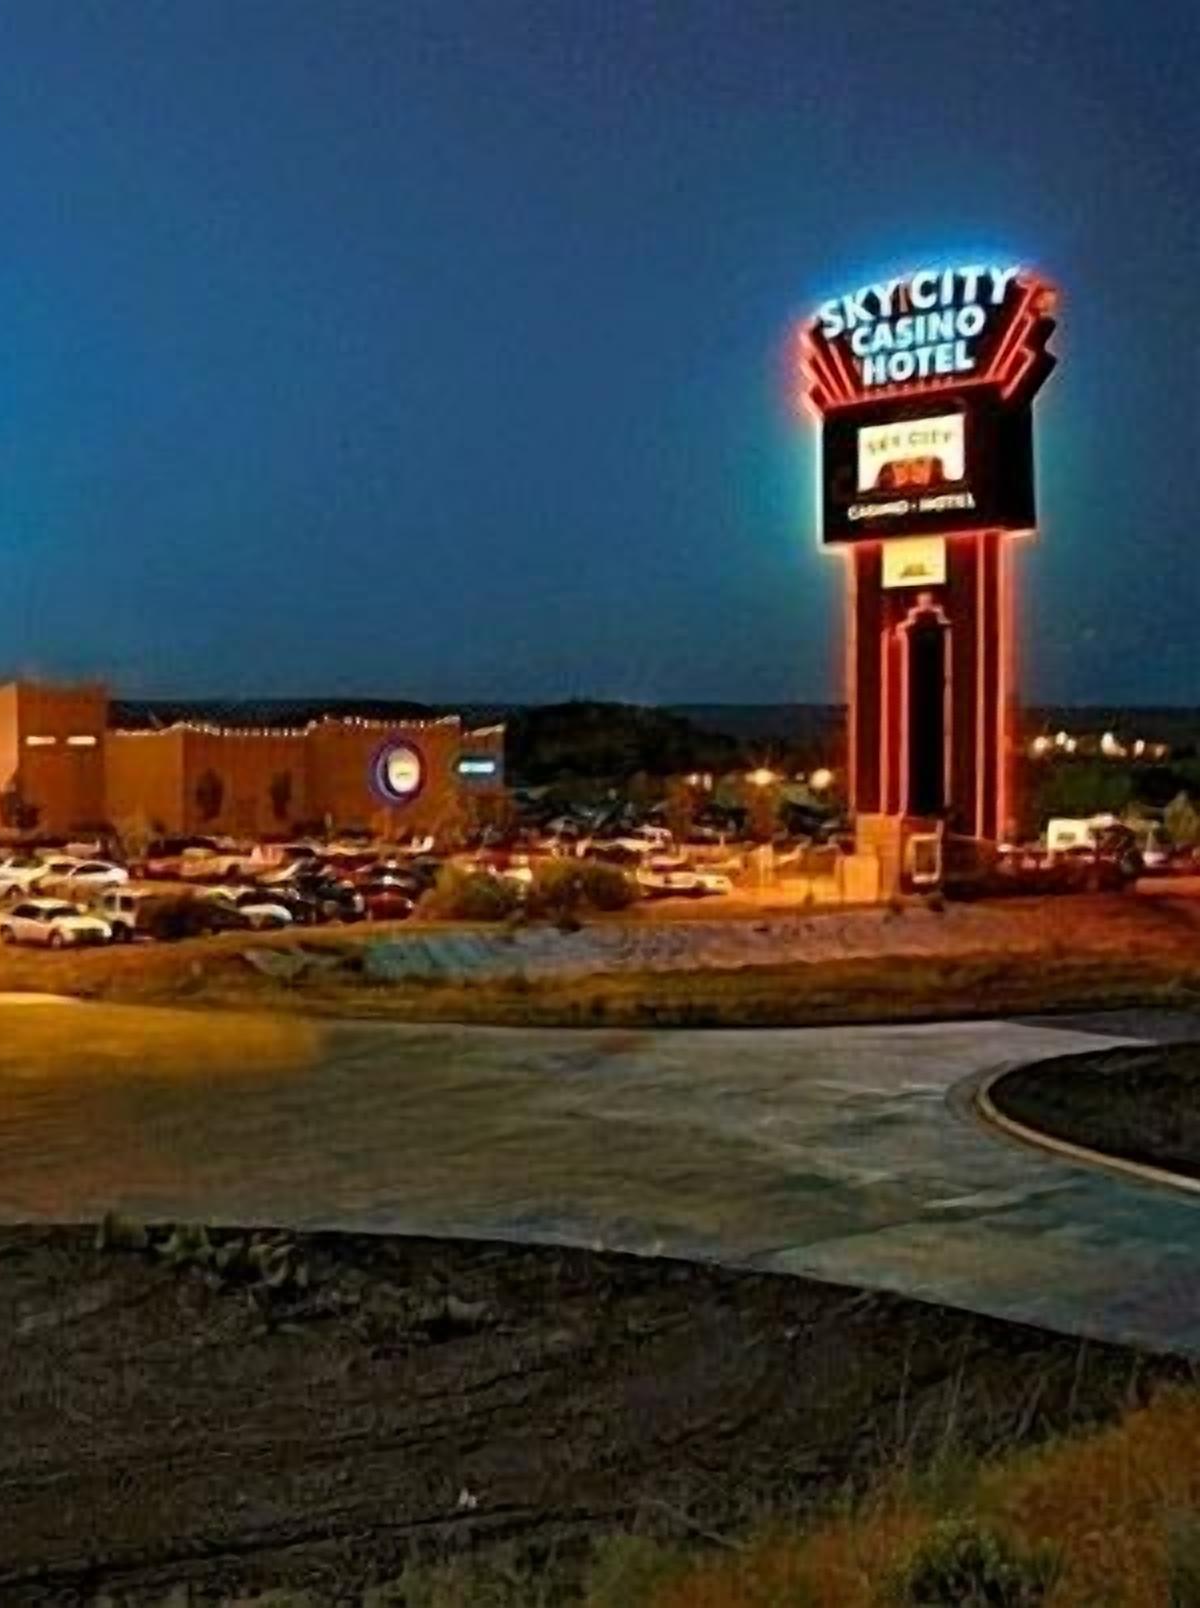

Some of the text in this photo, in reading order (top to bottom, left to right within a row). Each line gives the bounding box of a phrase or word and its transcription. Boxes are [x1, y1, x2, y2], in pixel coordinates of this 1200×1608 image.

[819, 266, 1019, 338] SKY CITY
[852, 304, 986, 357] CASINO
[861, 340, 975, 386] HOTEL
